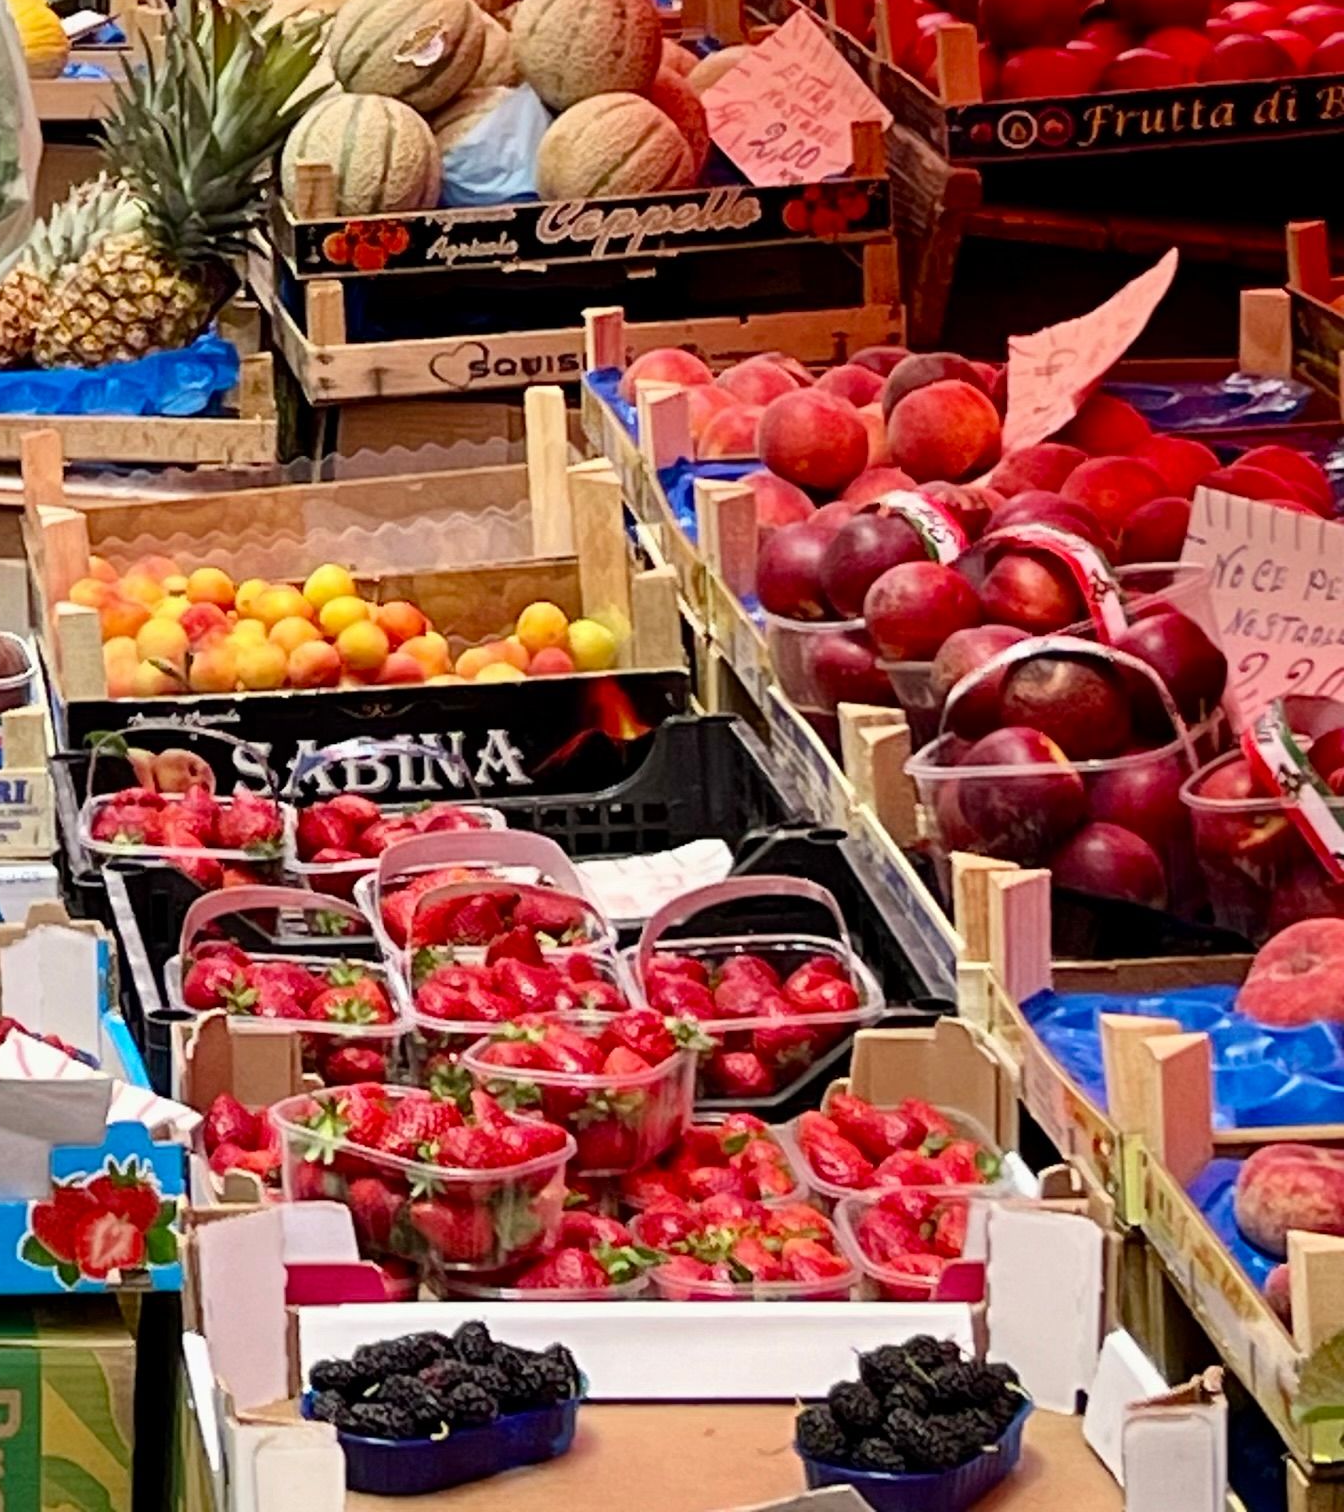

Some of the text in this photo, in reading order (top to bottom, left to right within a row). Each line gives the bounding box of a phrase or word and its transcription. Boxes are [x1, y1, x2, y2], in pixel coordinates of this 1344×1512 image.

[1076, 96, 1236, 147] Frutta
[1253, 86, 1299, 124] di
[536, 186, 762, 260] Cappello
[231, 728, 535, 798] SABINA
